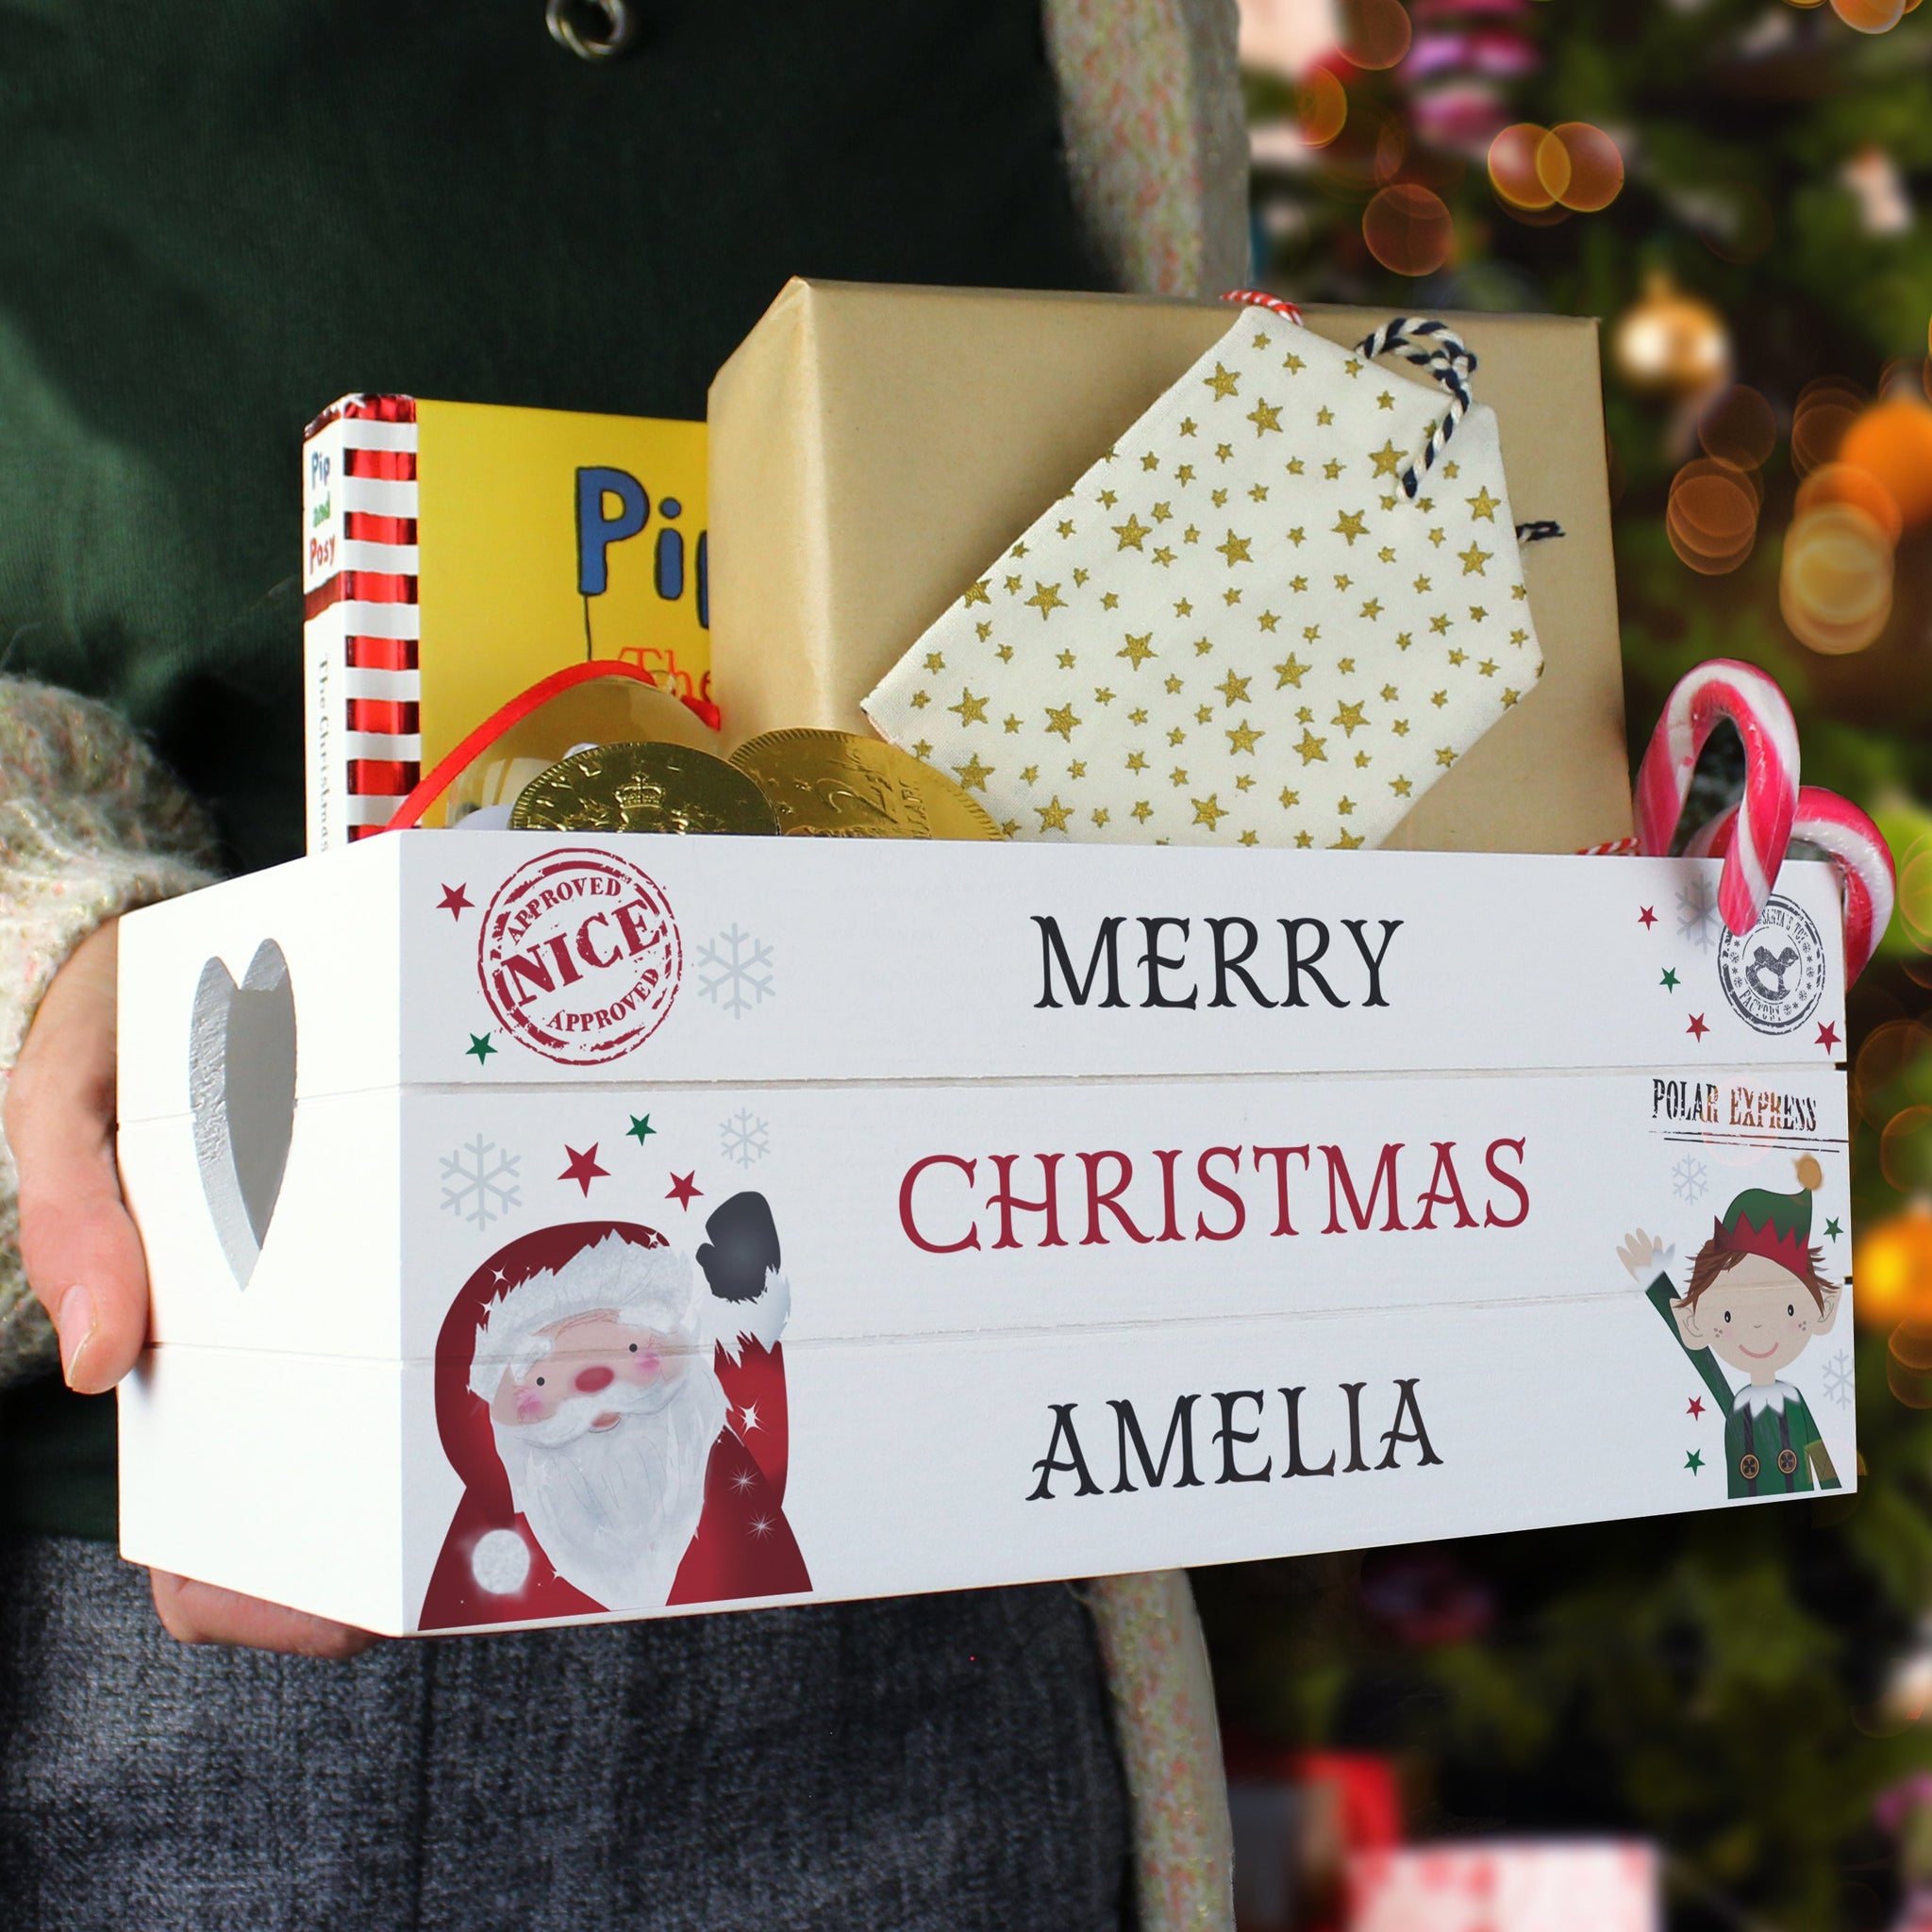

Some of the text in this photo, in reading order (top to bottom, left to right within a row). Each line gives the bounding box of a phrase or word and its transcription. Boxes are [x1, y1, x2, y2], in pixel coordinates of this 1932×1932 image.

[311, 452, 330, 490] Pip
[312, 491, 331, 528] and
[309, 534, 335, 575] Posy
[575, 465, 709, 630] Pi
[319, 651, 330, 853] The Christmas
[508, 876, 622, 946] APPROVED
[500, 899, 662, 1008] NICE
[1029, 915, 1405, 1010] MERRY
[545, 968, 659, 1032] APPROVED
[1739, 989, 1781, 1022] FACTORY
[1652, 1078, 1817, 1132] POLAR EXPRESS
[898, 1136, 1530, 1254] CHRISTMAS
[1024, 1377, 1444, 1502] AMELIA
